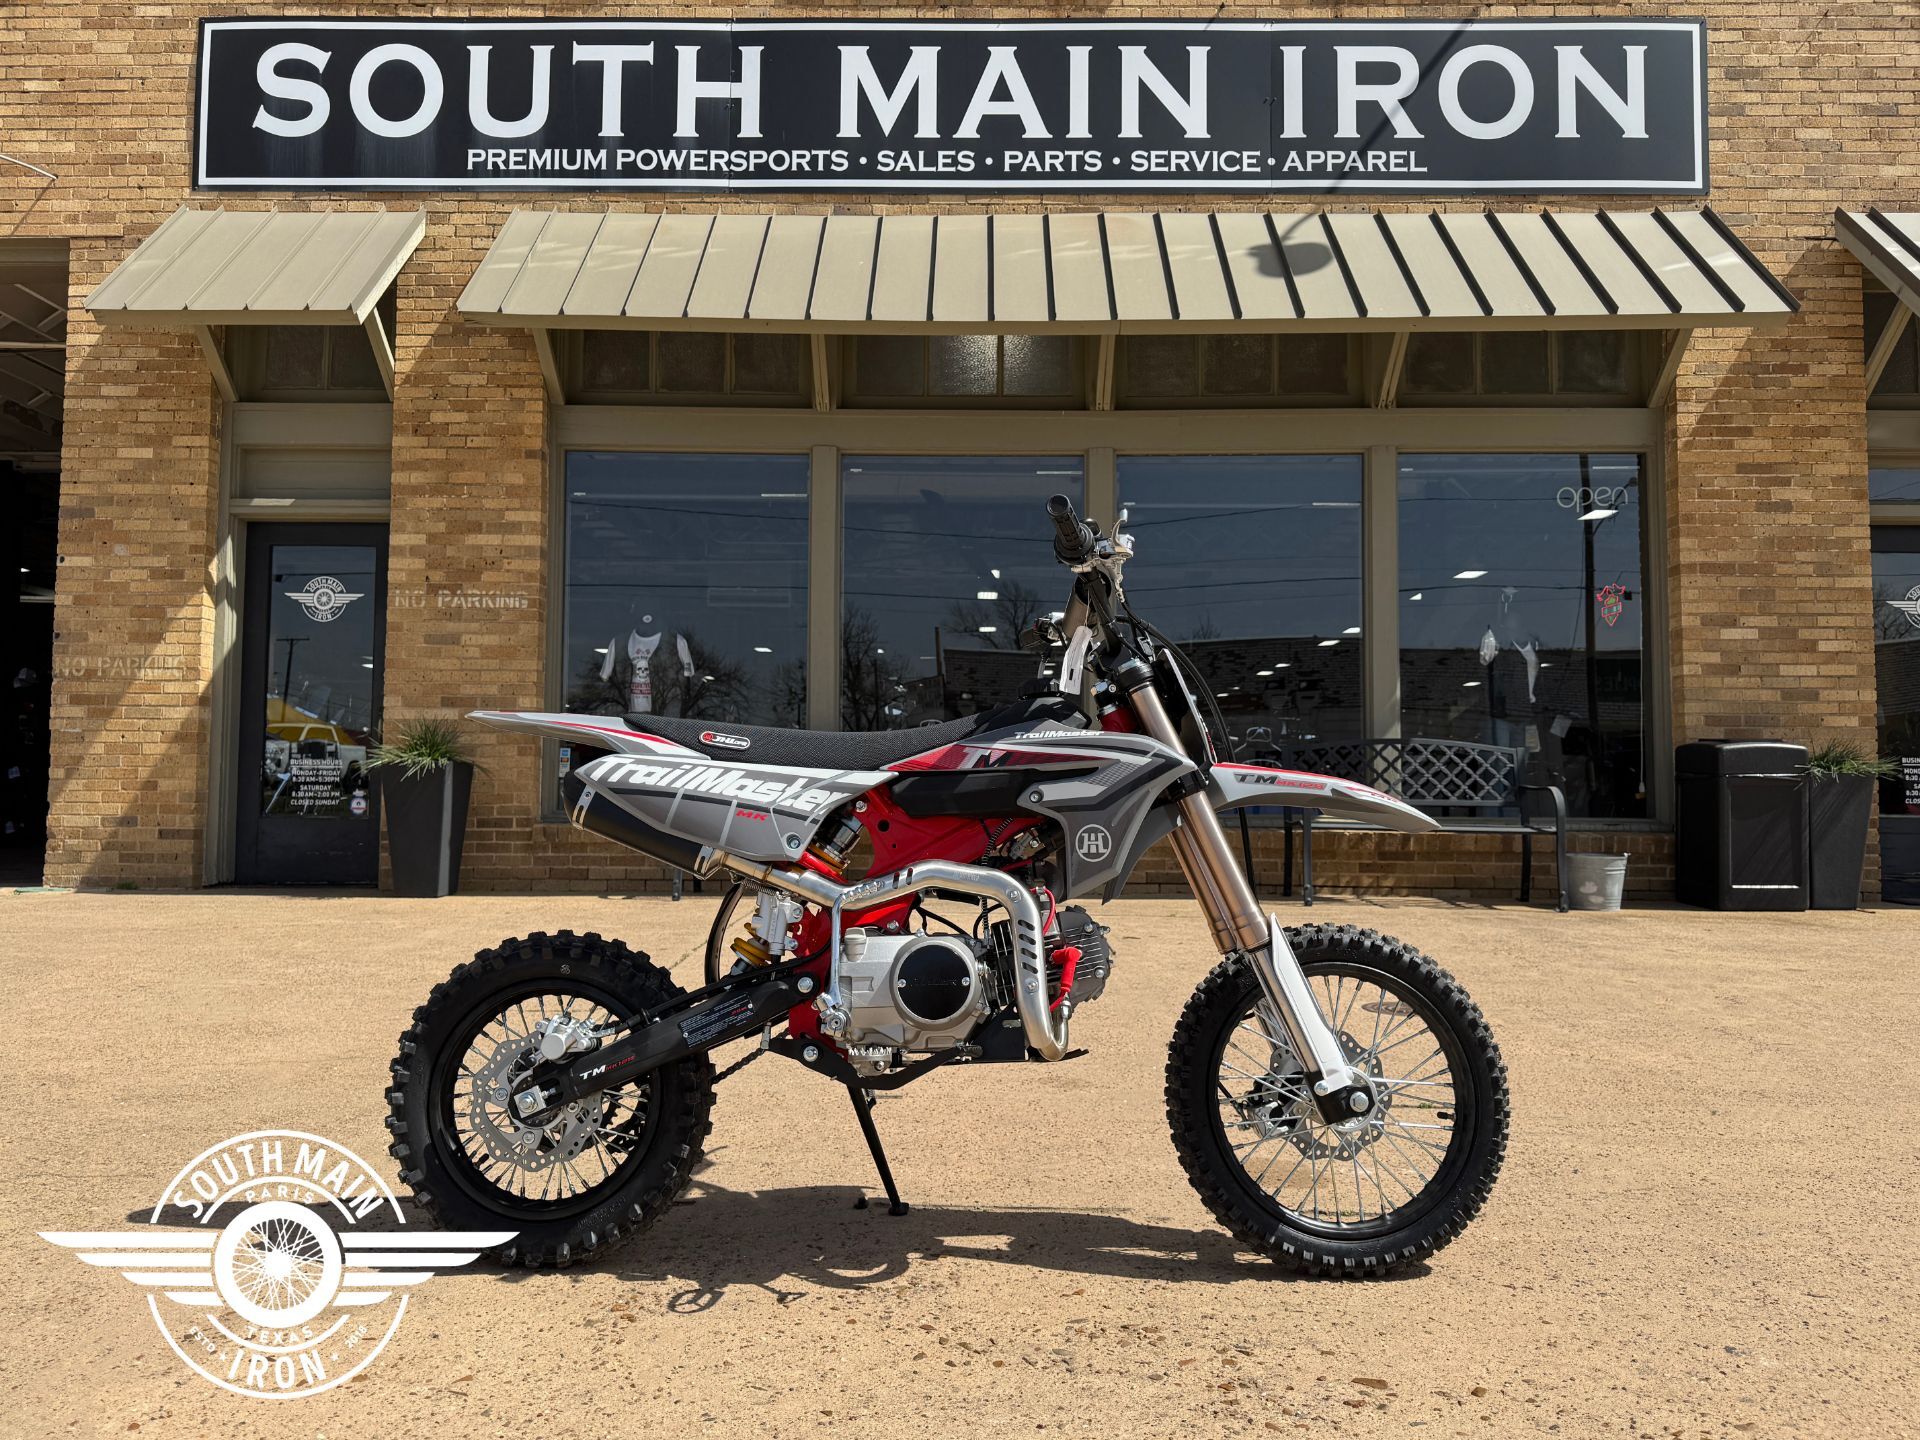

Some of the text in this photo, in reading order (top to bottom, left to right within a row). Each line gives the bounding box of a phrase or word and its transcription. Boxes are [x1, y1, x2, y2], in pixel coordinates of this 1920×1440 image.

[251, 40, 1650, 140] SOUTH MAIN IRON
[467, 148, 1428, 173] PREMIUM POWERSPORTS SALES PARTS SERVICE APPAREL
[1556, 486, 1629, 513] open
[395, 589, 529, 609] NO PARKING
[55, 655, 87, 677] NO
[1014, 729, 1105, 739] TrailMaster
[589, 756, 853, 815] TrailMaster
[579, 1064, 607, 1080] TM
